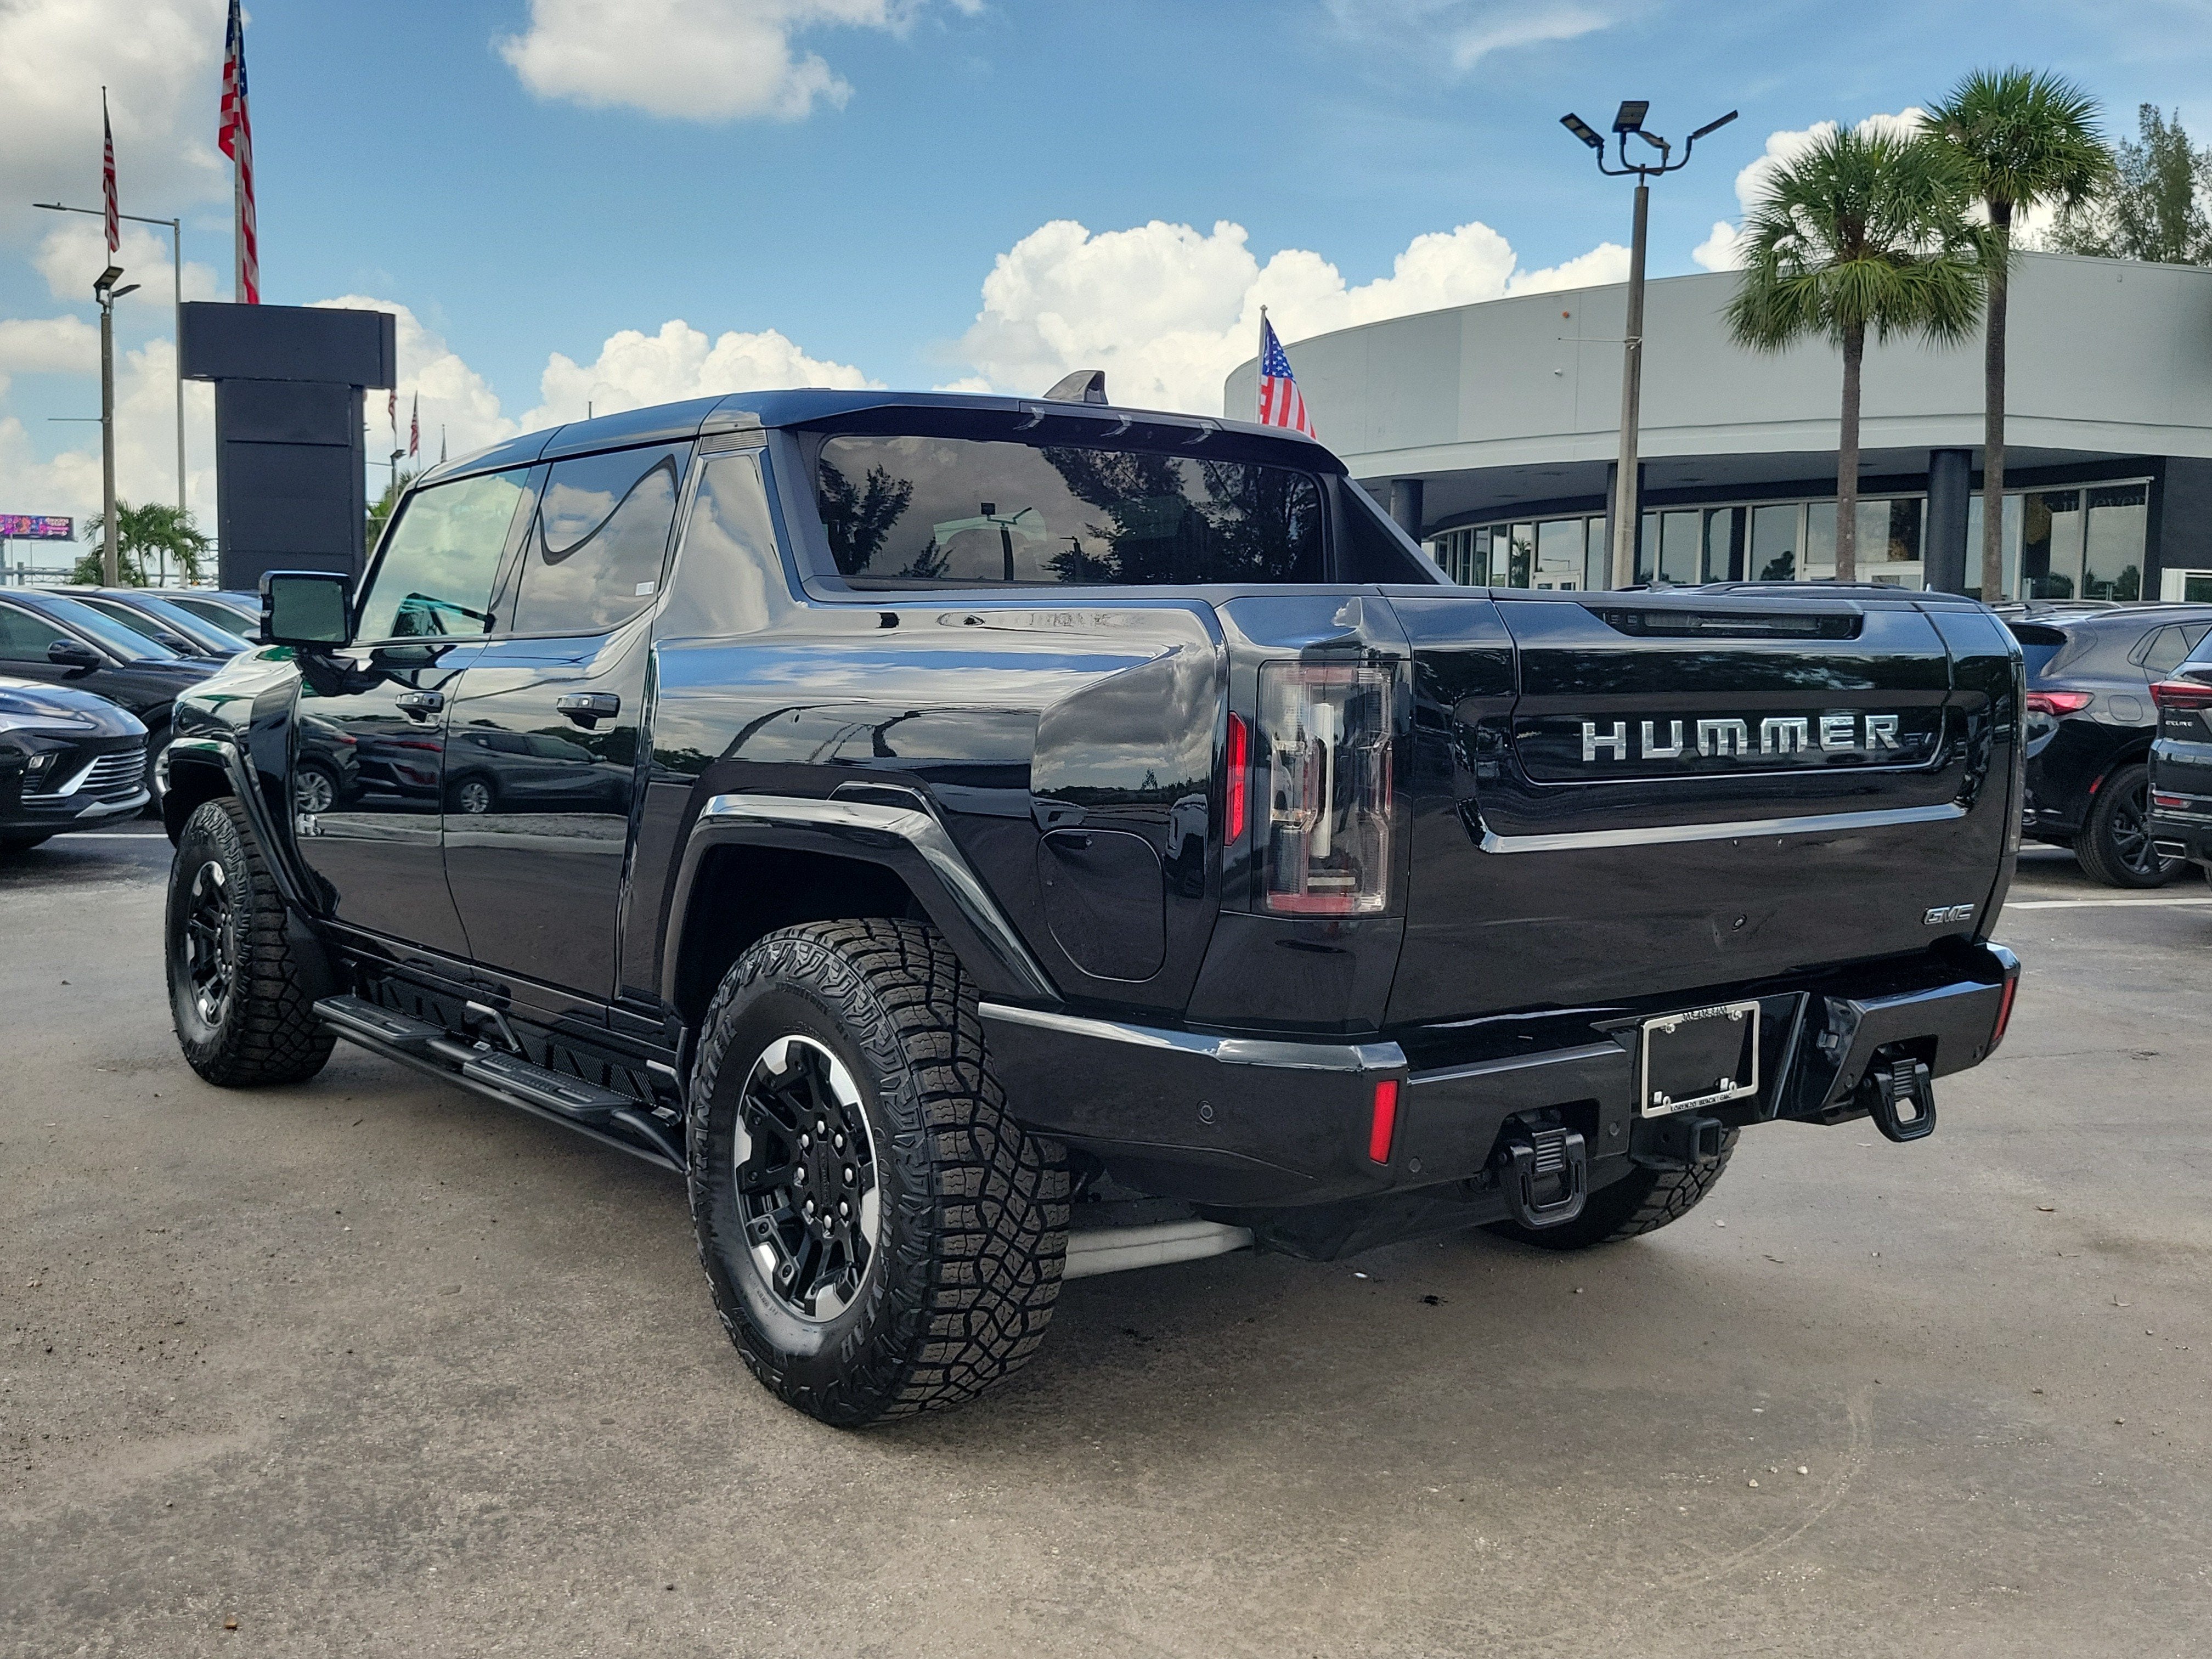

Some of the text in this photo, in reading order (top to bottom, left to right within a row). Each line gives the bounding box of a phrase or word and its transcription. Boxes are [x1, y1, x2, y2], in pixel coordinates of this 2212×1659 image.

[1582, 714, 1899, 761] HUMMER
[1924, 904, 1975, 926] GMC
[693, 1016, 738, 1214] WRANGLER
[1671, 1101, 1696, 1111] LORENZO
